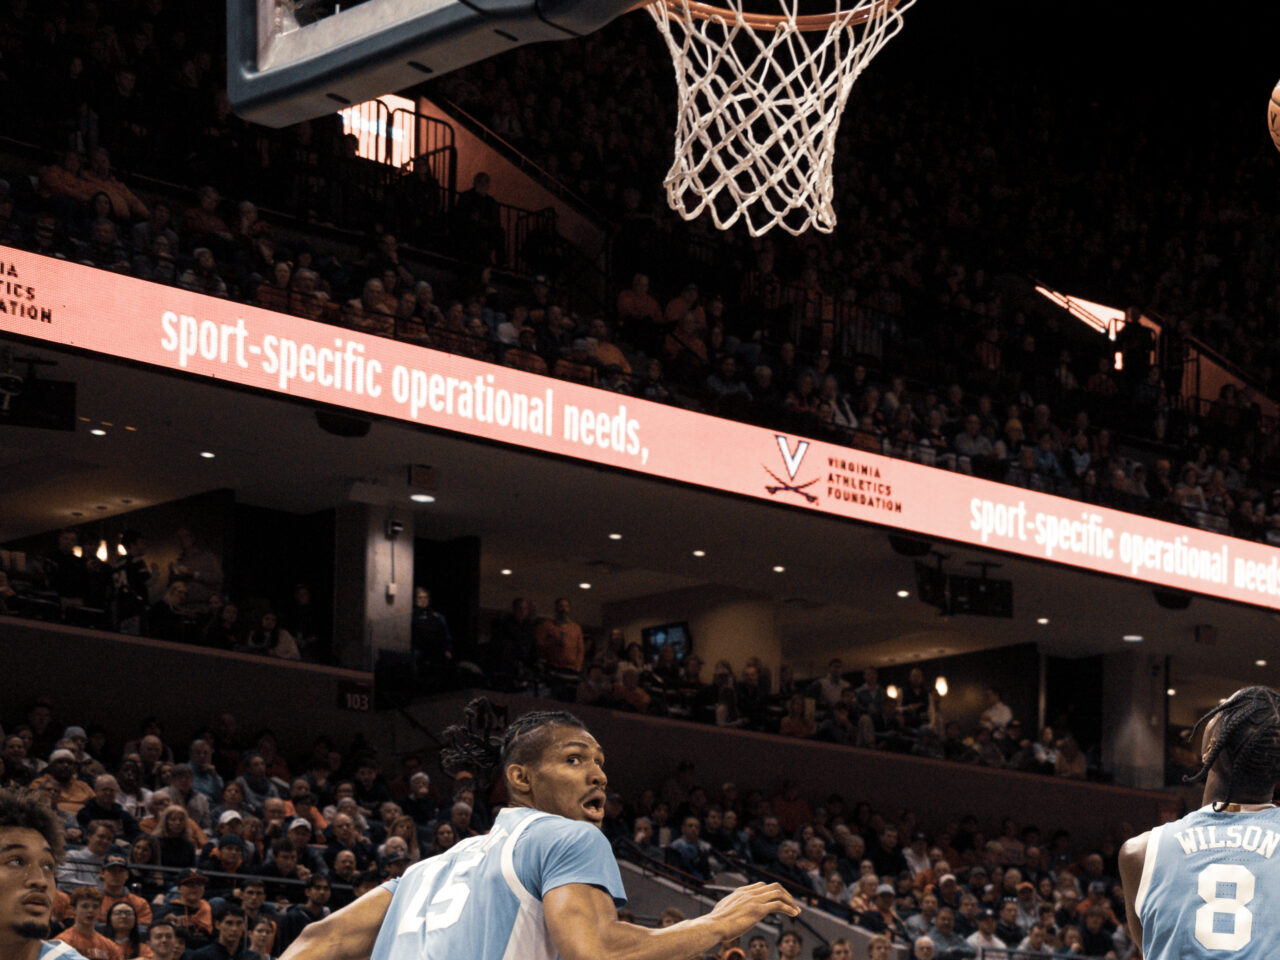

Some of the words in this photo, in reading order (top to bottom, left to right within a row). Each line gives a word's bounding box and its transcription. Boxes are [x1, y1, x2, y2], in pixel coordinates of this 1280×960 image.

[160, 310, 383, 399] sport-specific
[391, 364, 554, 437] operational
[563, 404, 650, 466] needs,
[827, 457, 881, 478] VIRGINIA
[827, 473, 892, 496] ATHLETICS
[827, 487, 903, 514] FOUNDATION
[970, 497, 1115, 557] sport-specific
[1119, 531, 1229, 584] operational
[397, 851, 486, 936] 15
[1194, 863, 1256, 951] 8
